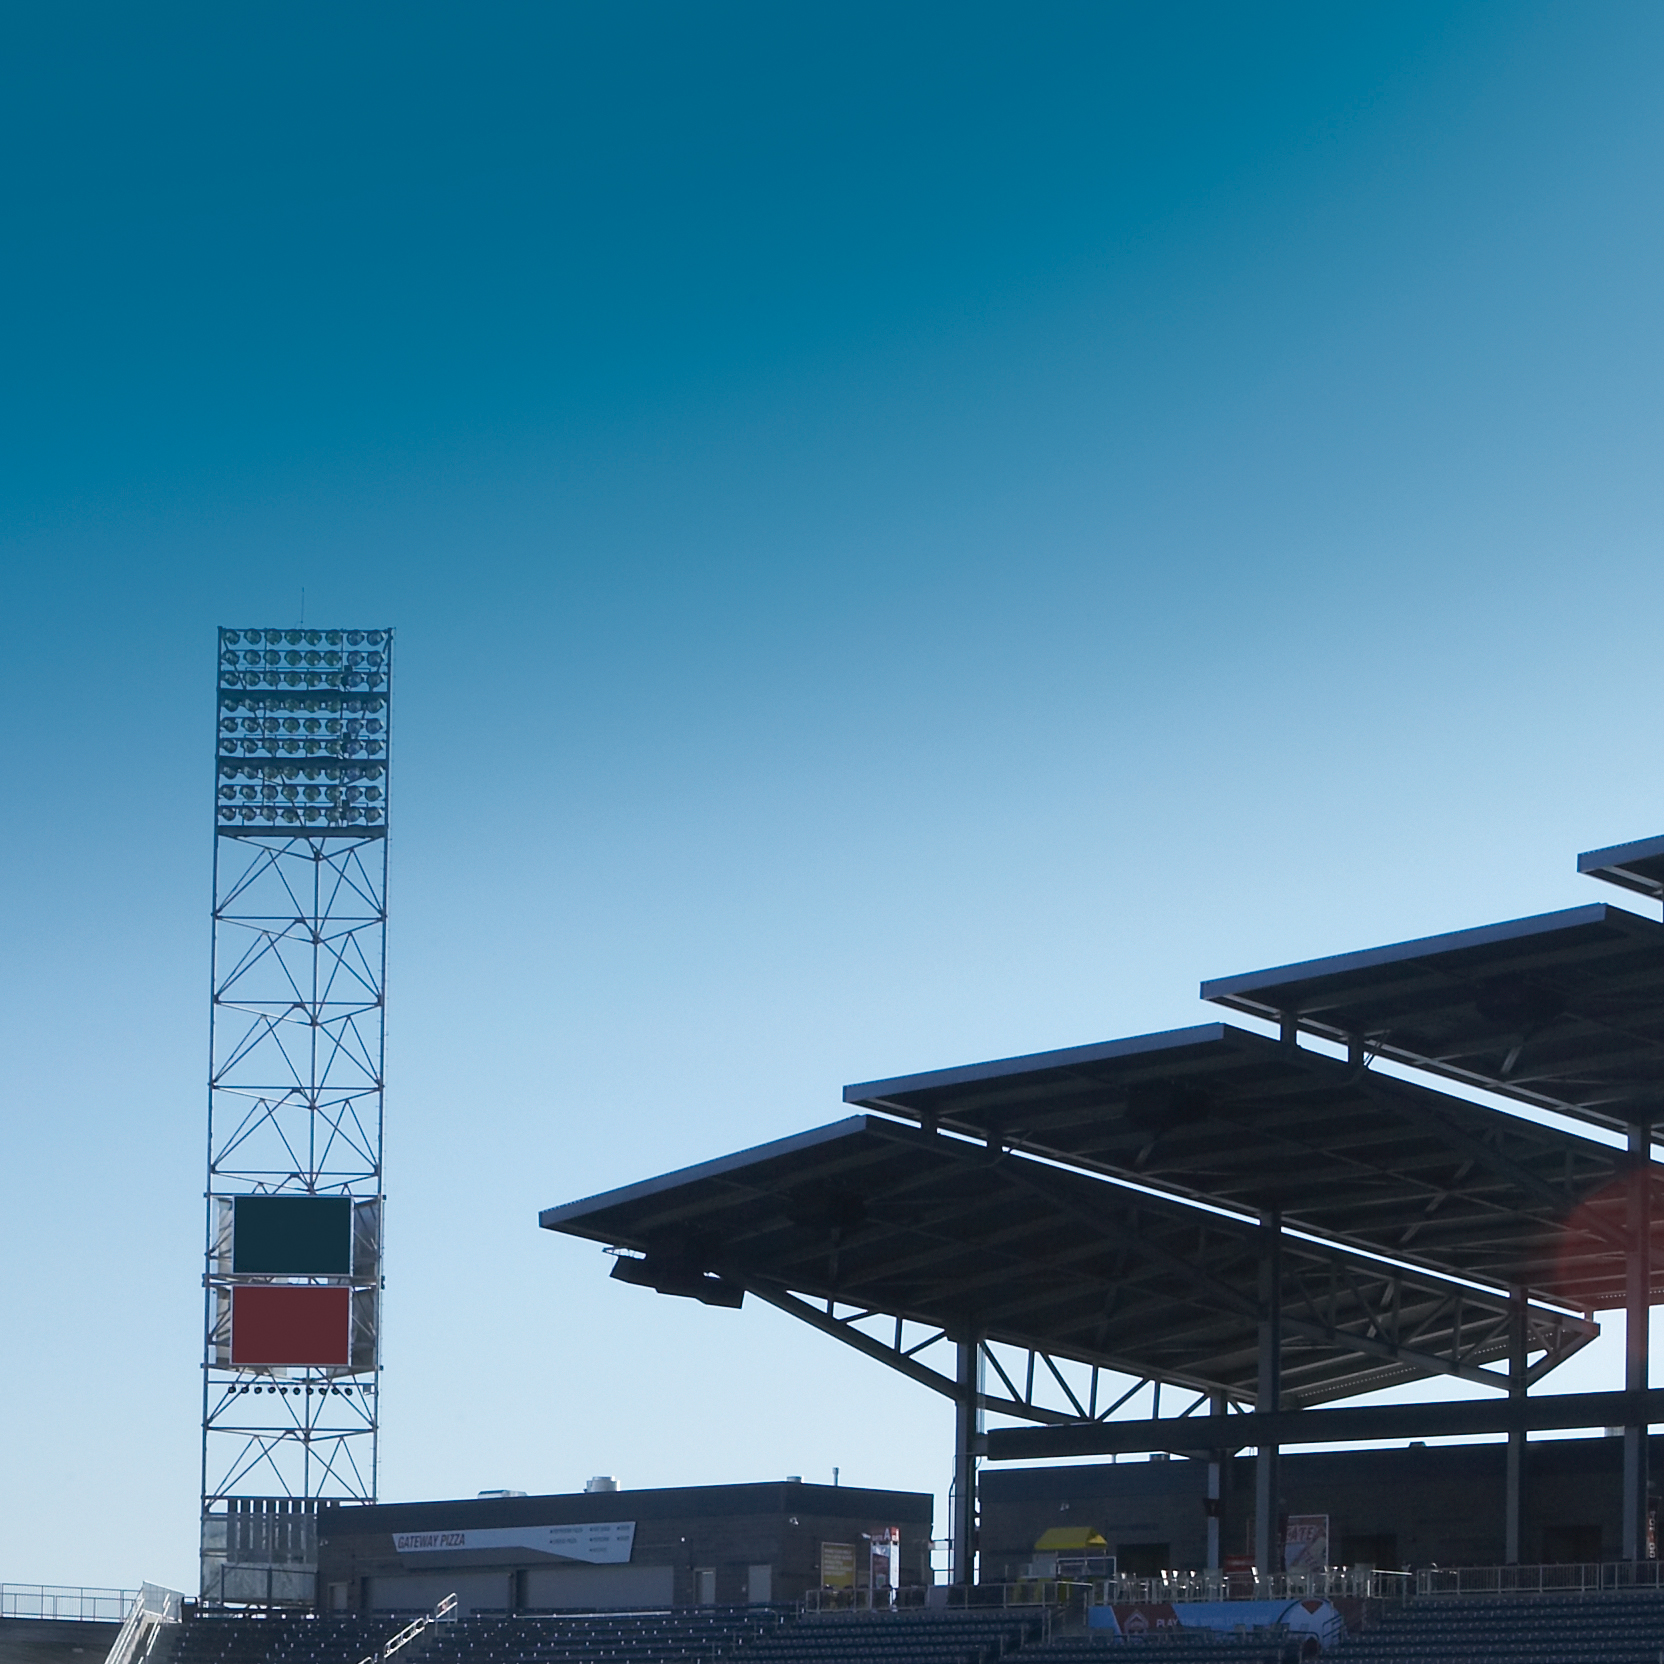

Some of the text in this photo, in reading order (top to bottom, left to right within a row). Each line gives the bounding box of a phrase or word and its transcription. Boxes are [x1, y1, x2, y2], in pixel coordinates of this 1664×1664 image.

[398, 1533, 465, 1549] GATEWAY PIZZA
[1156, 1618, 1178, 1628] PLAY
